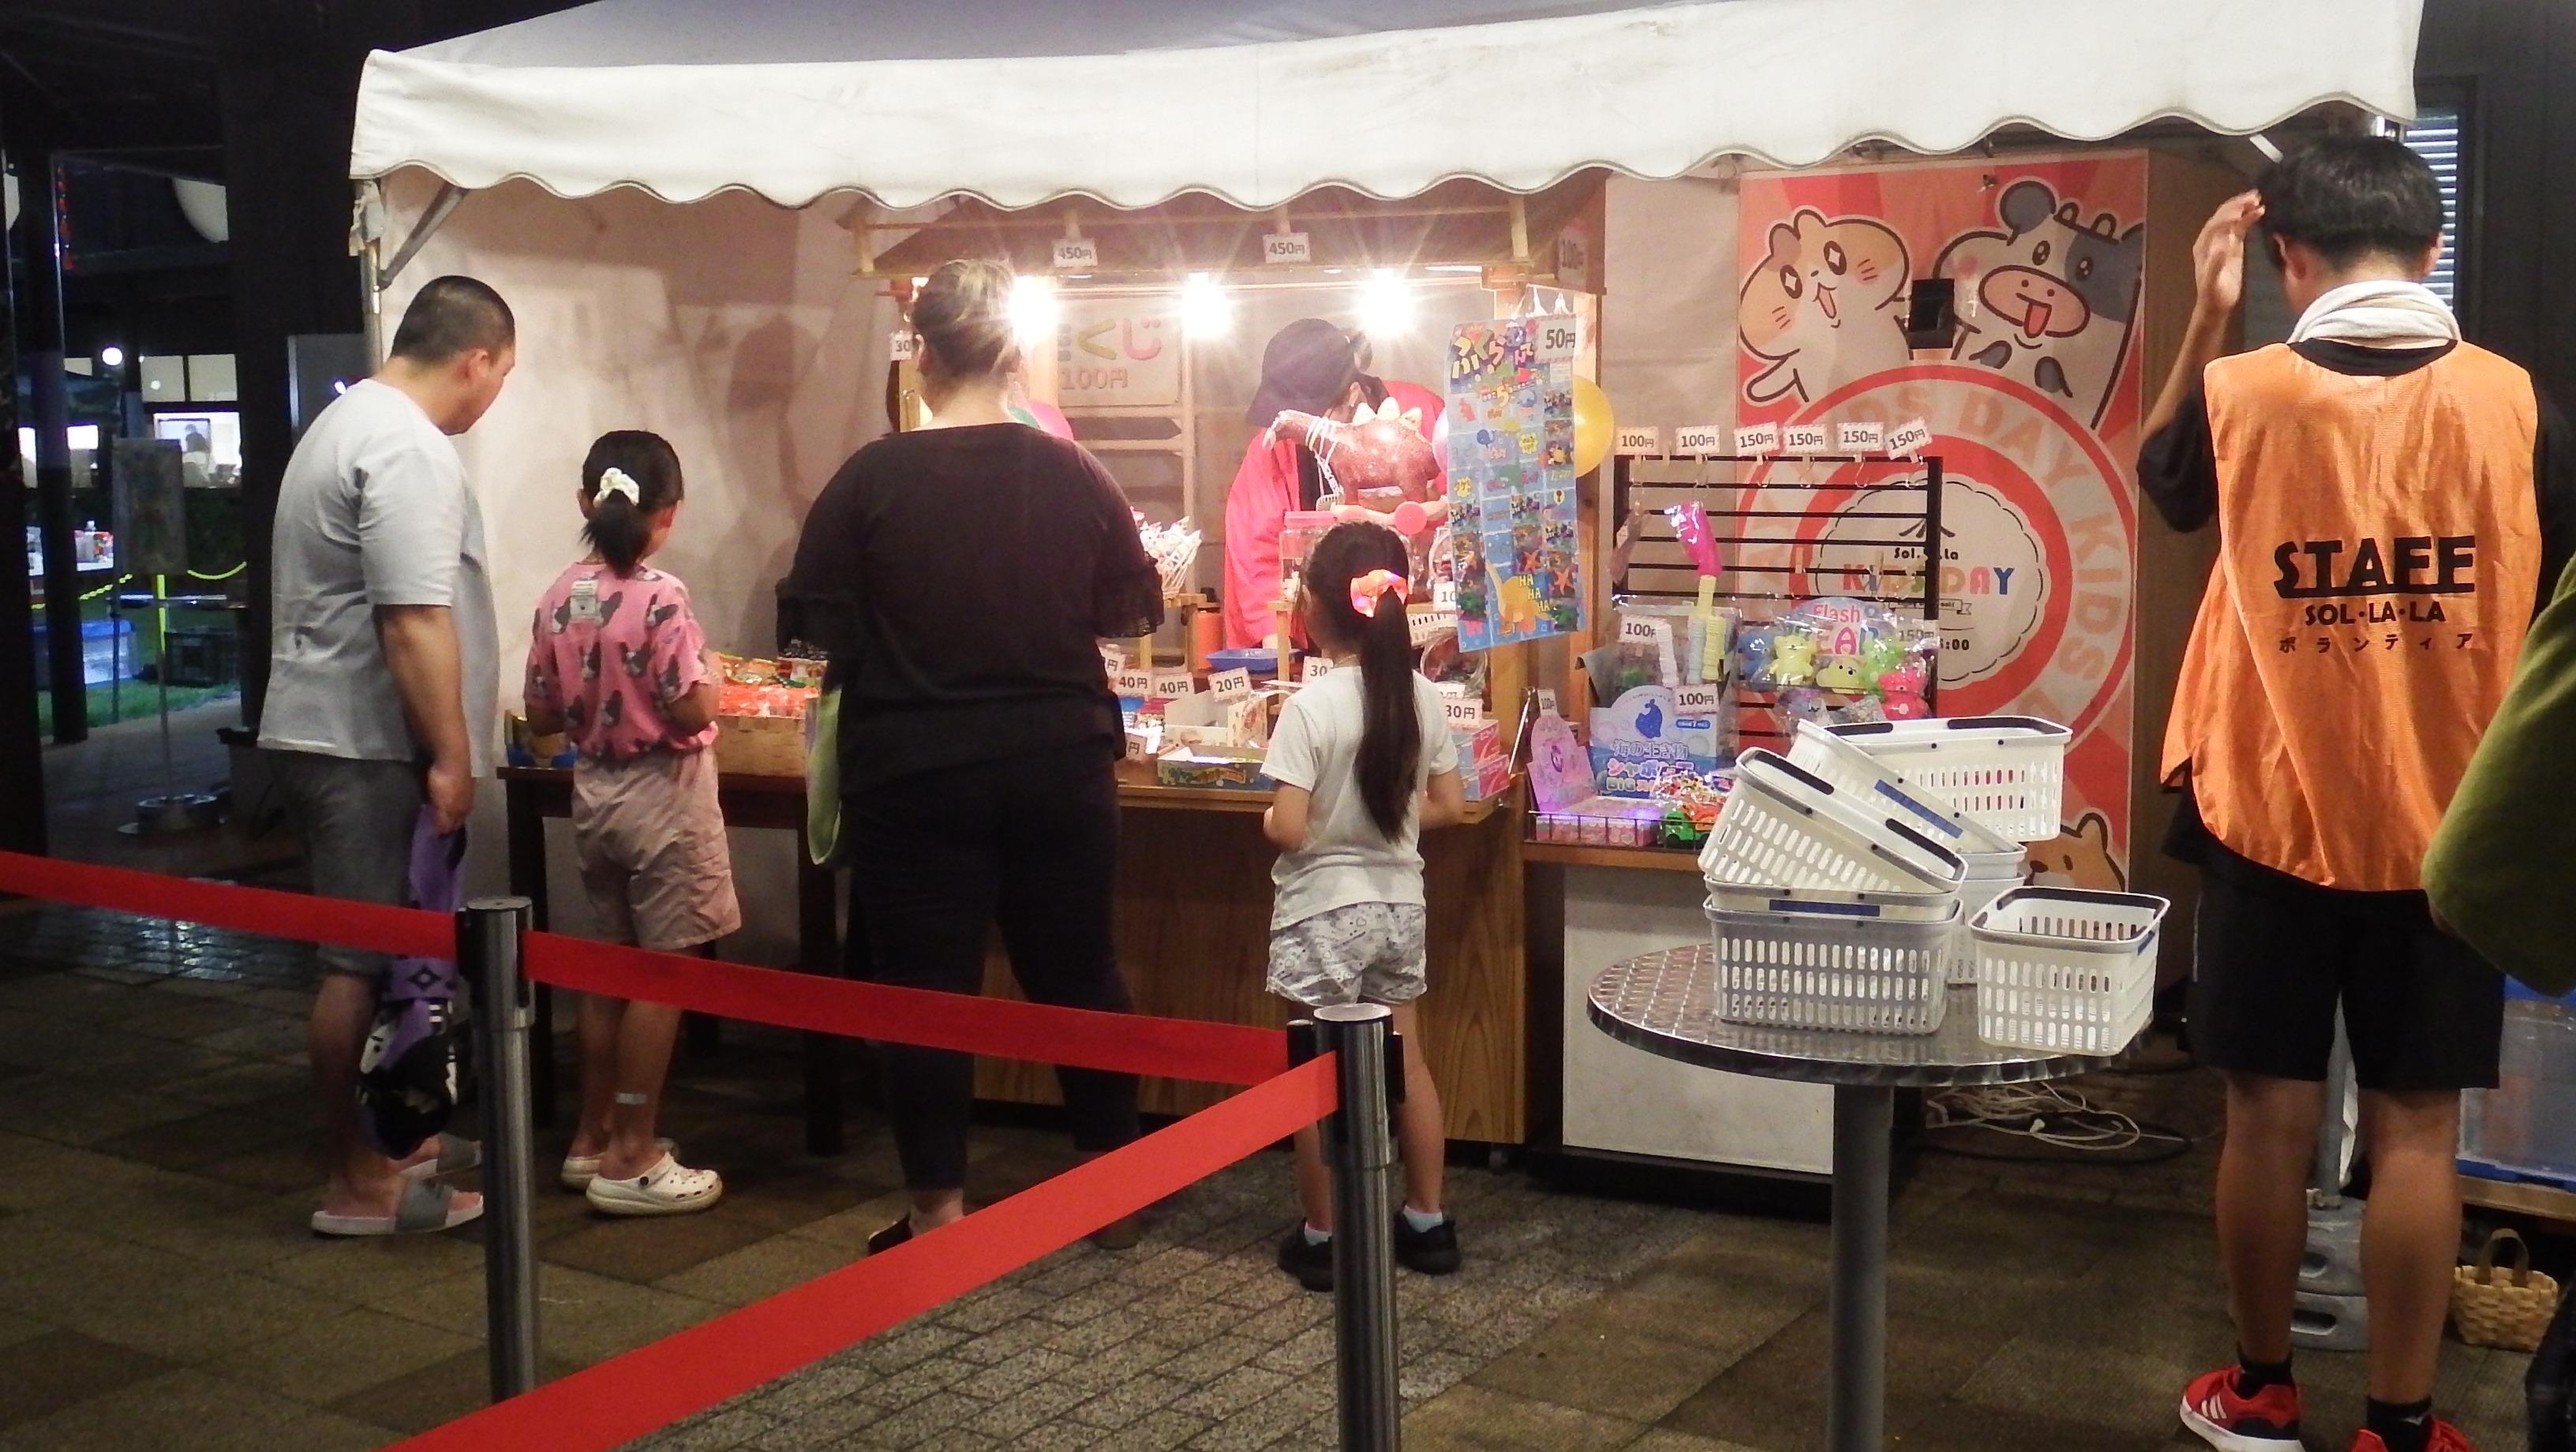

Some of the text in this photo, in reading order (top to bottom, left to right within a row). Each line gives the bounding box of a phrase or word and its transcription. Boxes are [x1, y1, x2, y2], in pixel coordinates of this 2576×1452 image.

[1058, 247, 1092, 261] 450円
[1270, 241, 1306, 256] 450円
[1545, 327, 1576, 350] 50円
[1621, 435, 1654, 448] 100円
[1681, 434, 1715, 447] 100円
[1739, 432, 1774, 448] 150円
[1788, 432, 1823, 447] 150円
[1843, 431, 1879, 444] 150円
[1889, 428, 1926, 450] 150円
[2274, 534, 2476, 599] STAFF
[1519, 574, 1534, 588] HA
[1940, 566, 2016, 595] DAY
[1527, 587, 1541, 600] HA
[1537, 599, 1550, 613] HA
[1813, 604, 1861, 623] Flash
[2278, 632, 2473, 654] ボランティア
[1118, 676, 1148, 689] 40円
[1159, 681, 1189, 694] 40円
[1215, 675, 1245, 692] 20円
[1679, 692, 1714, 705] 100円
